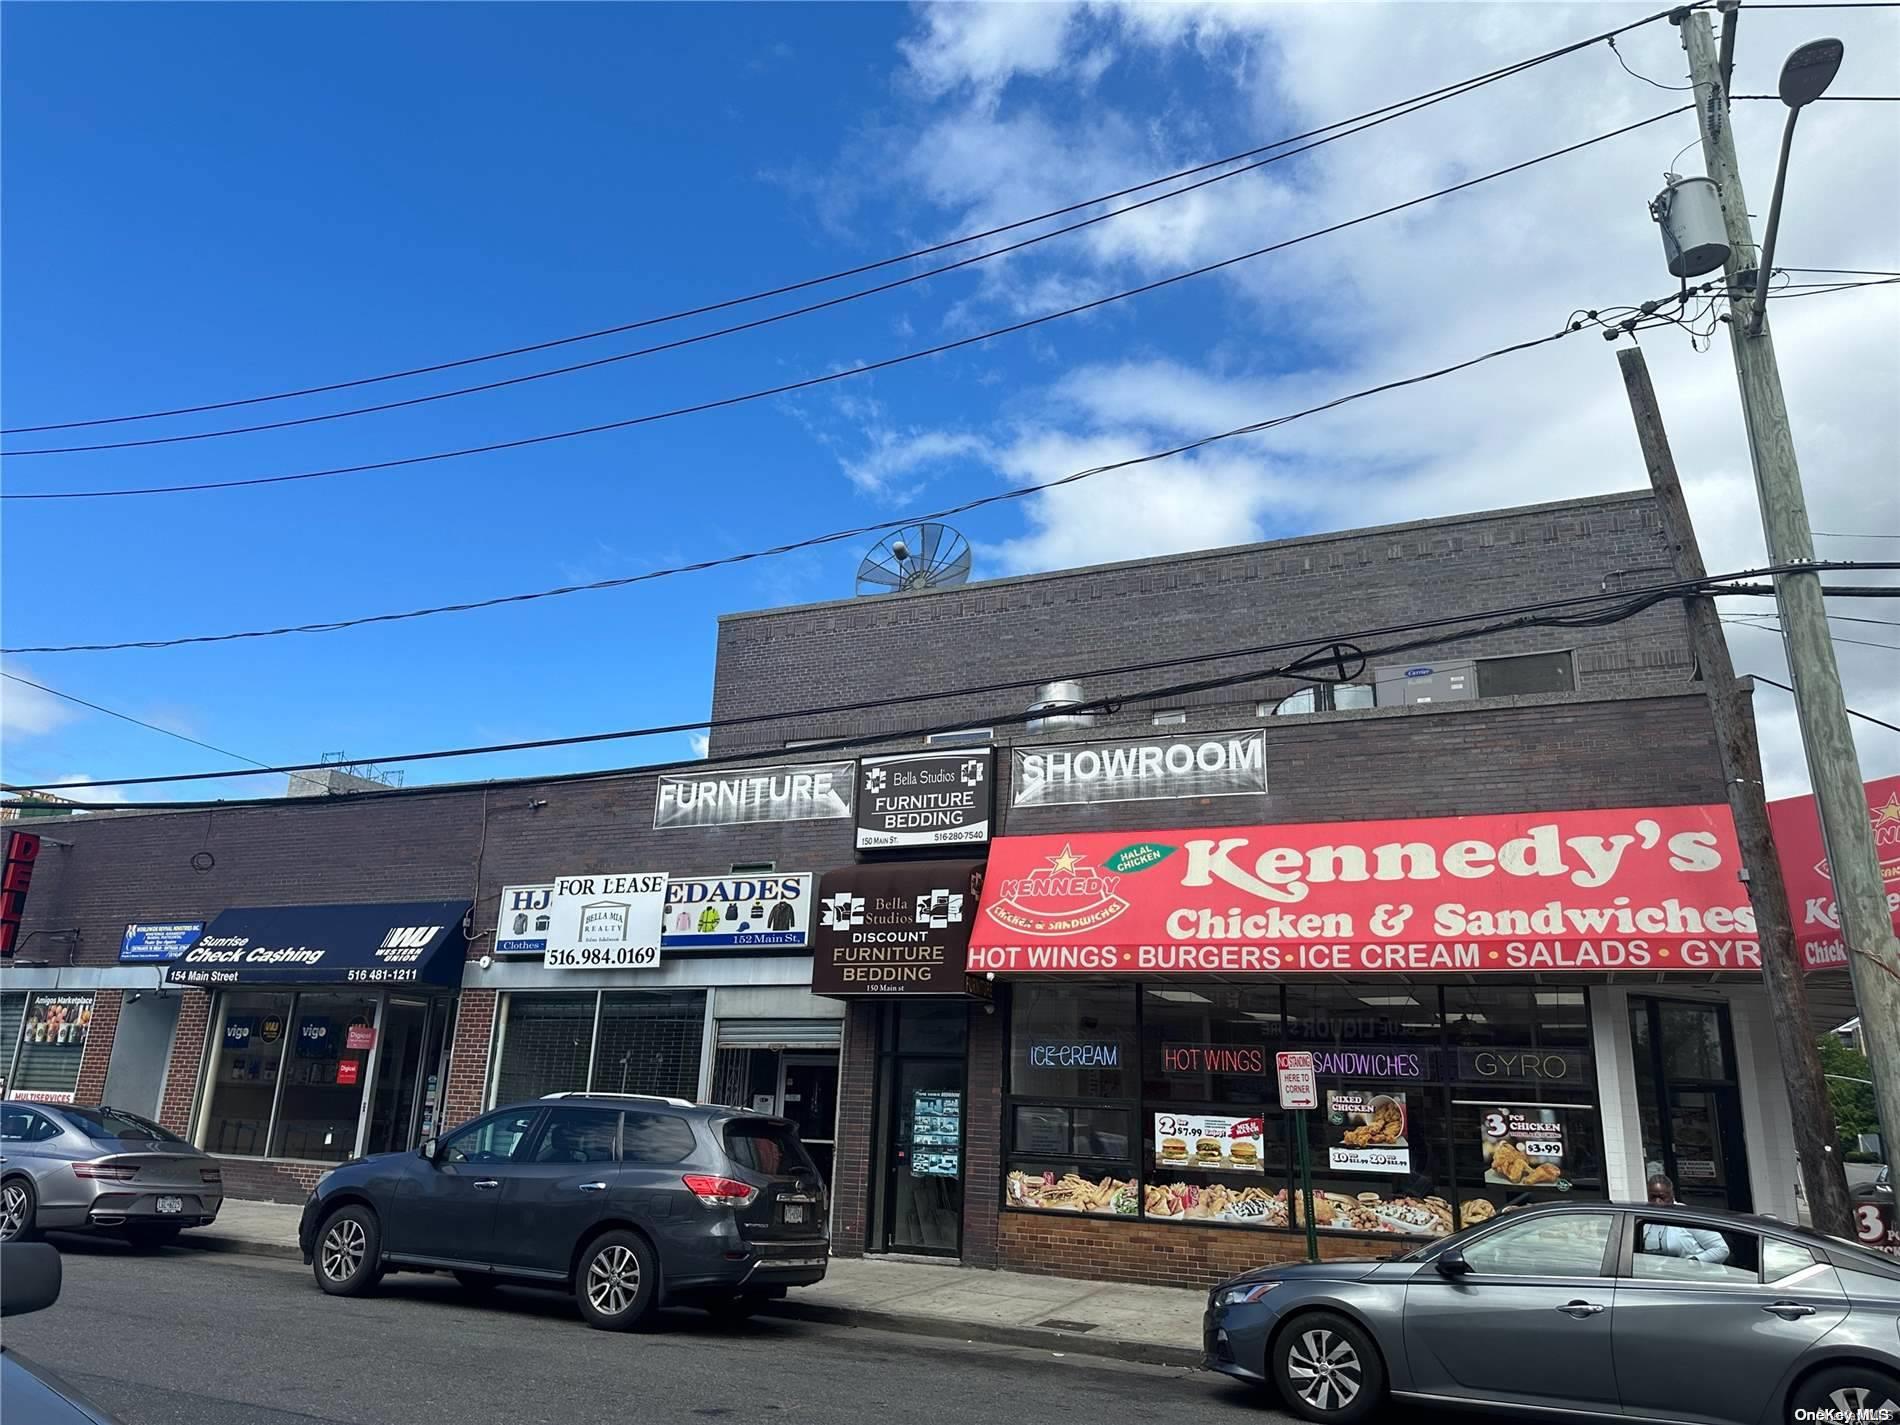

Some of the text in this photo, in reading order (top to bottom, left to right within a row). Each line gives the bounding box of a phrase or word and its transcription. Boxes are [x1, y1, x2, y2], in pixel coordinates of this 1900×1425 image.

[1022, 738, 1262, 784] SHOWROOM
[893, 769, 955, 786] Bella Studios
[659, 773, 833, 810] FURNITURE
[875, 791, 974, 811] FURNITURE
[885, 811, 963, 828] BEDDING
[862, 837, 872, 846] 150
[934, 831, 983, 841] 516-280-7540
[1117, 850, 1161, 872] CHICKEN
[1121, 845, 1153, 862] HALAL
[0, 831, 40, 954] DELI
[558, 876, 663, 896] FOR LEASE
[664, 878, 801, 904] EDADES
[1000, 876, 1120, 898] KENNEDY
[876, 898, 908, 910] Bella
[585, 911, 623, 924] BELLA MIA
[865, 912, 913, 925] Studios
[1166, 897, 1758, 940] Chicken & Sandwiches
[200, 935, 249, 947] Sunrise
[733, 933, 801, 944] 152 Main St.
[852, 931, 929, 943] DISCOUNT
[503, 941, 539, 950] Clothes
[1805, 938, 1848, 964] Chick
[185, 947, 246, 962] Check
[549, 947, 656, 965] 516.984.0169
[833, 946, 944, 961] FURNITURE
[968, 940, 1762, 969] HOT WINGS BURGERS ICE CREAM SALADS GYR
[171, 970, 238, 982] 154 Main Street
[347, 969, 417, 980] 516 481-1211
[843, 967, 931, 981] BEDDING
[866, 984, 878, 992] 150
[879, 984, 897, 992] Main
[35, 995, 93, 1006] Amigos Marketplace
[227, 1024, 249, 1039] vigo
[302, 1024, 327, 1039] vigo
[1059, 1046, 1117, 1066] CREAM
[1164, 1049, 1262, 1073] HOT WINGS
[1279, 1055, 1311, 1069] NO STANDING
[1313, 1051, 1420, 1077] SANDWICHES
[1475, 1052, 1567, 1079] GYRO
[1284, 1074, 1310, 1082] HERE TO
[1285, 1085, 1311, 1094] CORNER
[15, 1092, 71, 1103] MULTISERVICES
[1331, 1096, 1362, 1104] MIXED
[1332, 1104, 1375, 1112] CHICKEN
[1159, 1116, 1176, 1136] 2
[1178, 1127, 1202, 1137] $7.99
[1486, 1113, 1507, 1137] 3
[1510, 1122, 1560, 1132] CHICKEN
[1527, 1144, 1560, 1154] $3.99
[1333, 1152, 1348, 1162] 10
[1370, 1154, 1386, 1164] 20
[1858, 1205, 1883, 1240] 3
